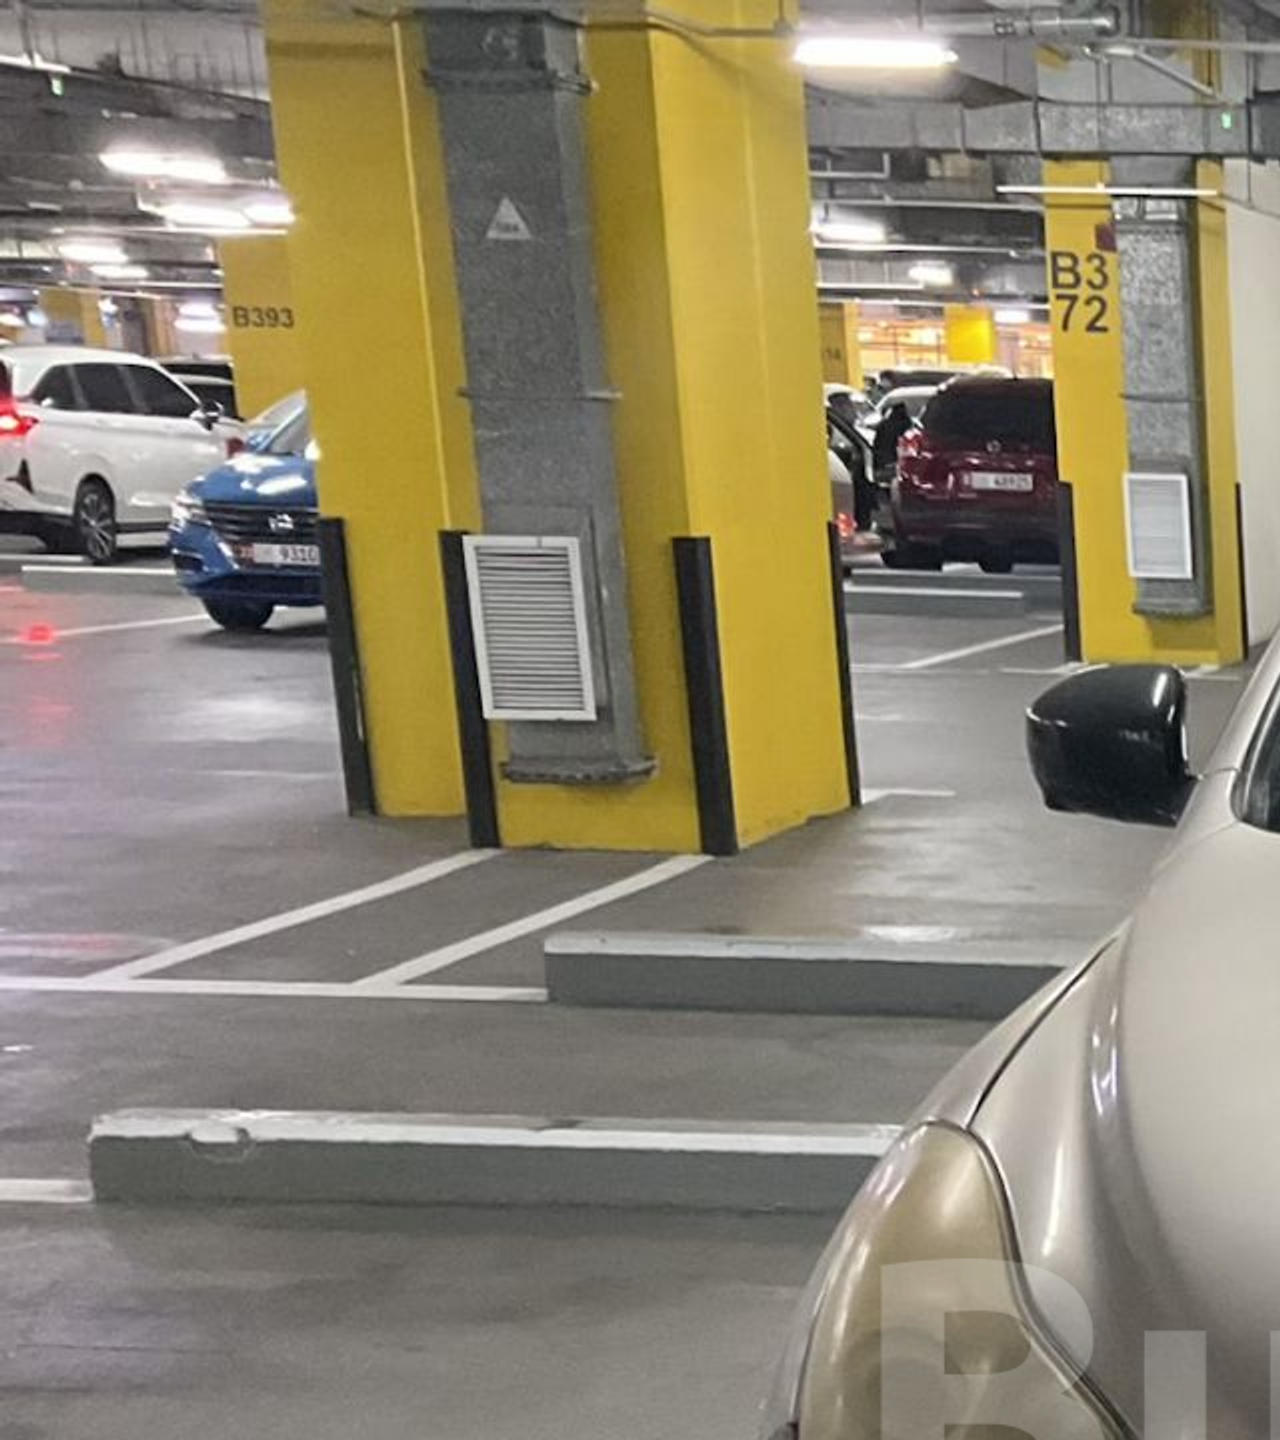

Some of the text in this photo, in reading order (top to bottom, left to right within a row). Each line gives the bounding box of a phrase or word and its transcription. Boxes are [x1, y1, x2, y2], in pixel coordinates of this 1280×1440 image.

[1051, 251, 1109, 290] B3
[233, 306, 295, 329] B393
[1055, 293, 1109, 332] 72
